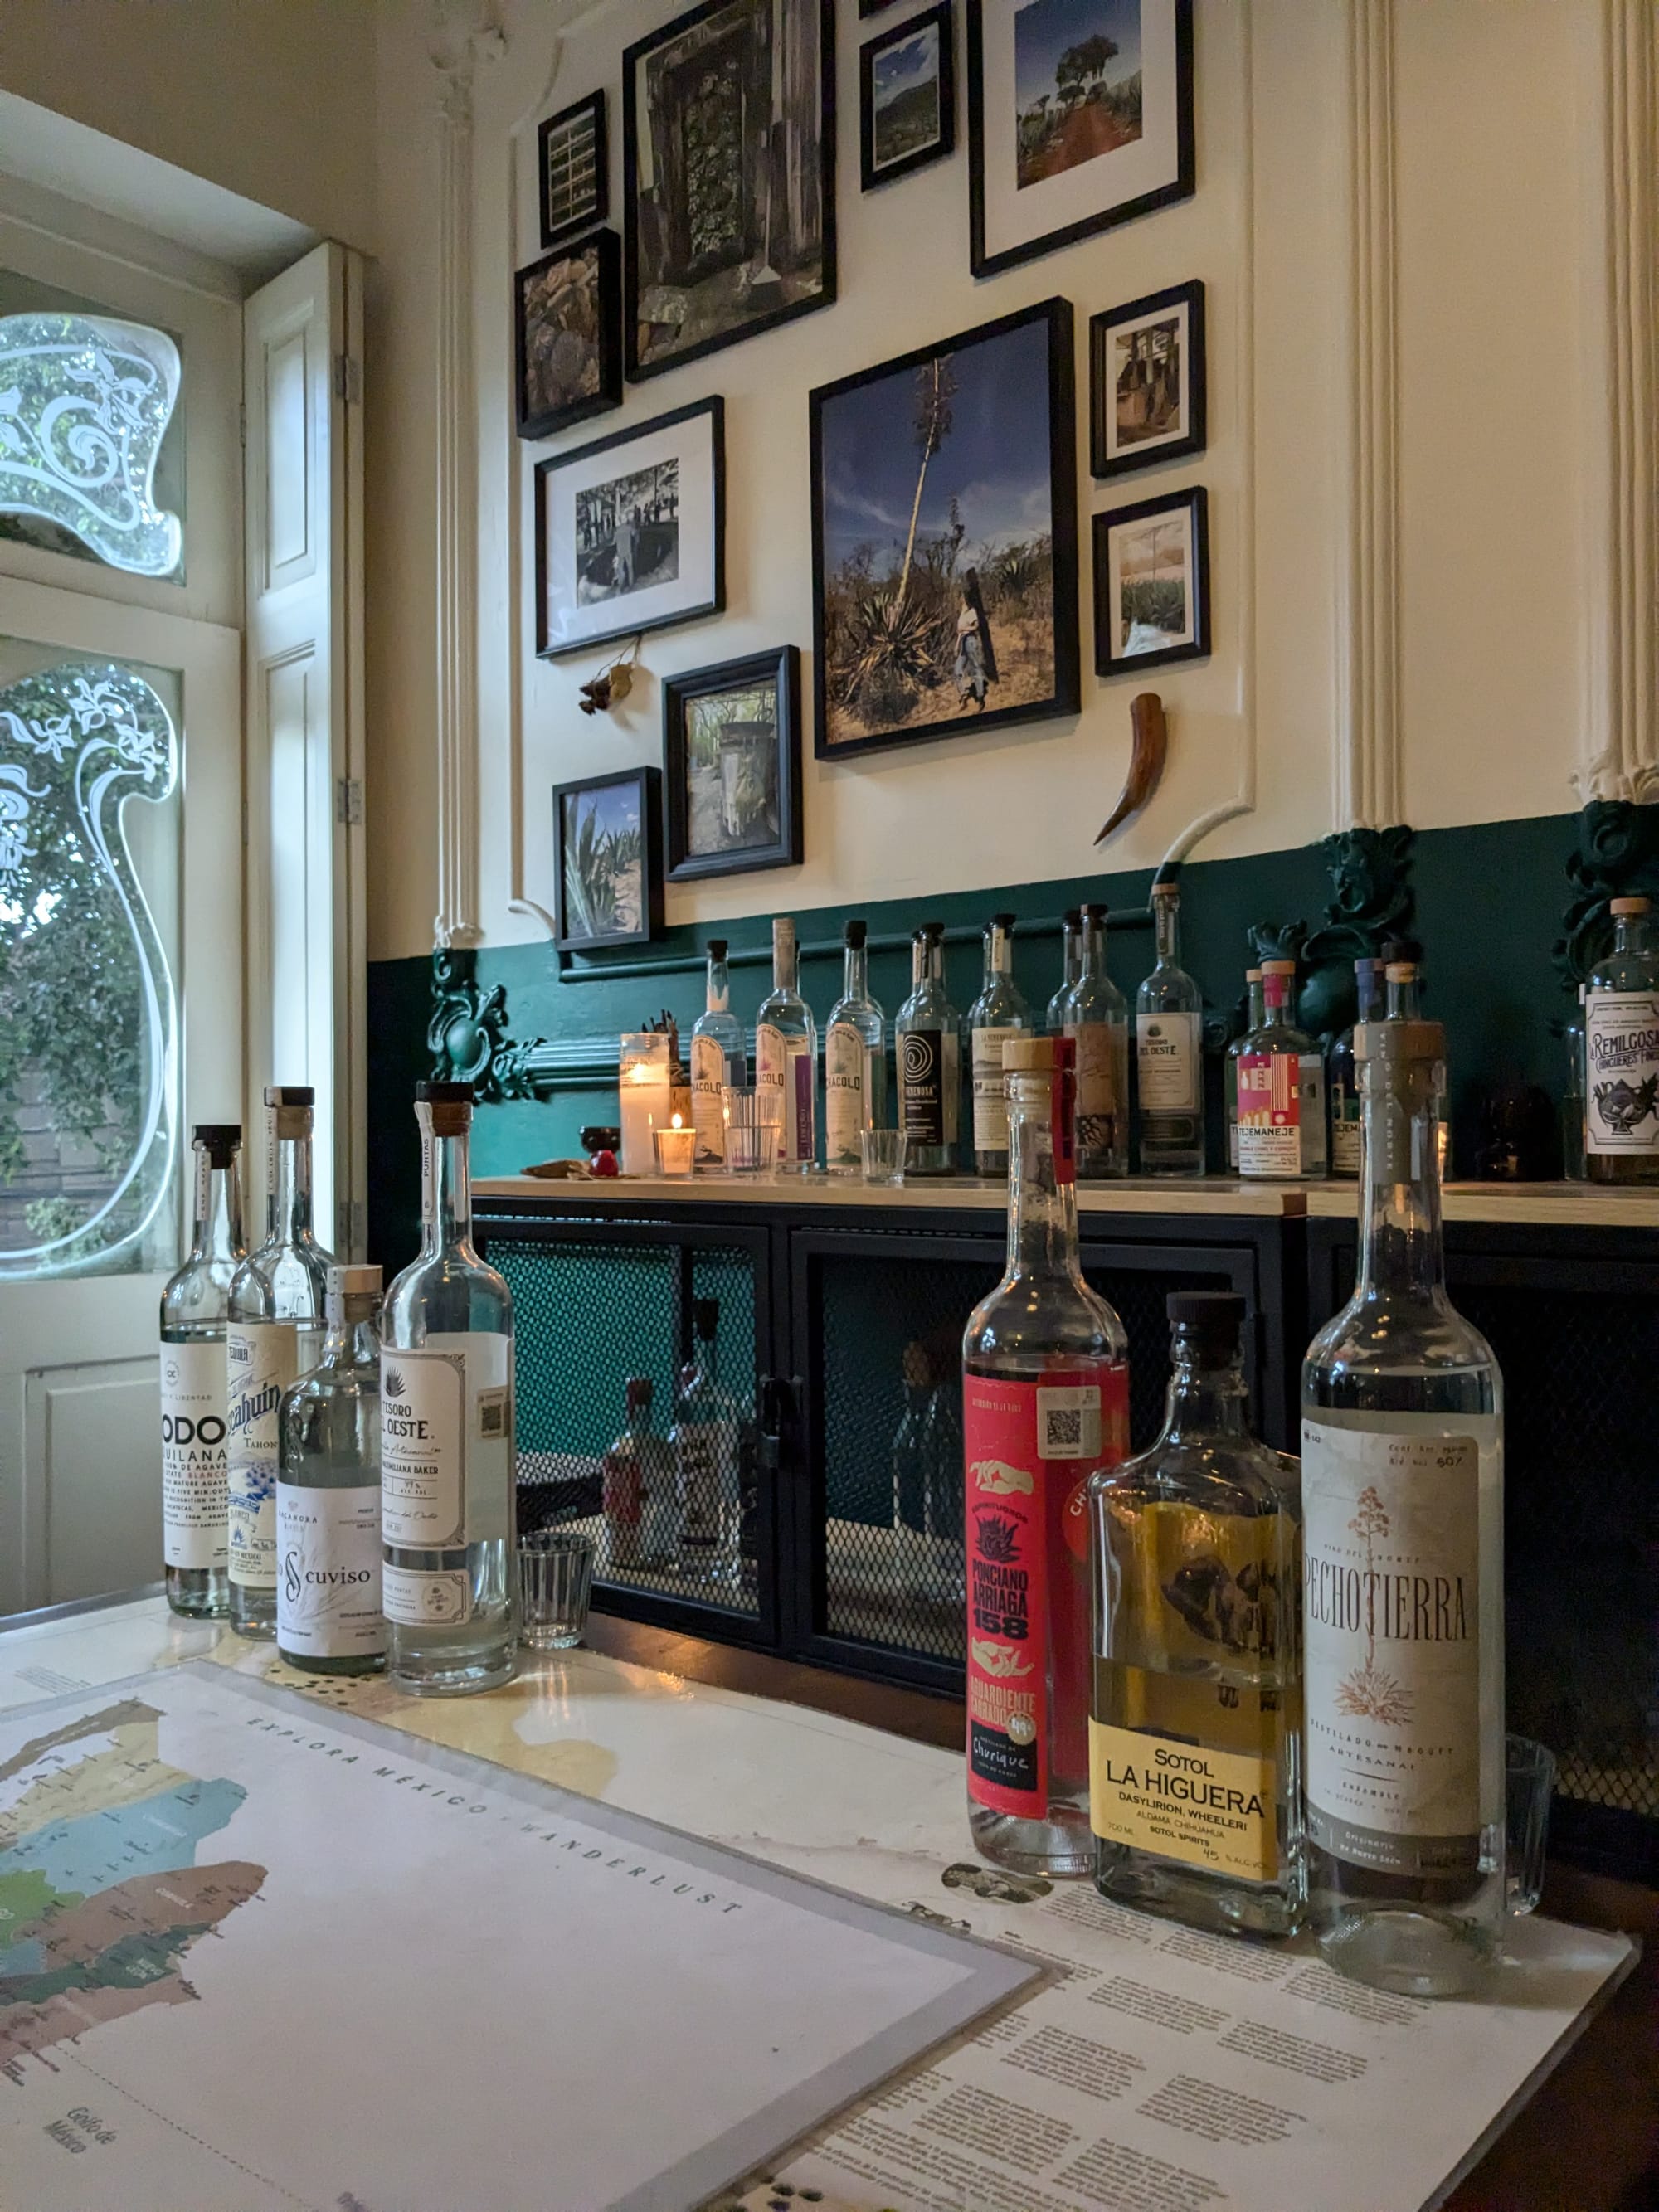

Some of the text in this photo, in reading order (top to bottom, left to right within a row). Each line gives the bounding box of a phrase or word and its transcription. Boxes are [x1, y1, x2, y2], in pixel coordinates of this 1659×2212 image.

[1239, 1127, 1295, 1137] TEJEMANEJE
[188, 1471, 227, 1479] BLANCO
[196, 1461, 227, 1471] AGAVE
[414, 1466, 438, 1475] BAKER
[202, 1479, 227, 1487] AGAVE
[972, 1558, 1029, 1592] PONCIANO
[973, 1581, 1029, 1618] ARRIAGA
[1304, 1552, 1467, 1641] PECHOTIERRA
[973, 1607, 1029, 1641] 158
[1107, 1759, 1140, 1789] LA
[1155, 1748, 1215, 1778] SOTOL
[246, 1718, 359, 1764] EXPLORA
[519, 1823, 742, 1913] WANDERLUST
[1188, 1808, 1248, 1832] WHEELERI
[1149, 1825, 1211, 1848] SOTOL SPIRITS
